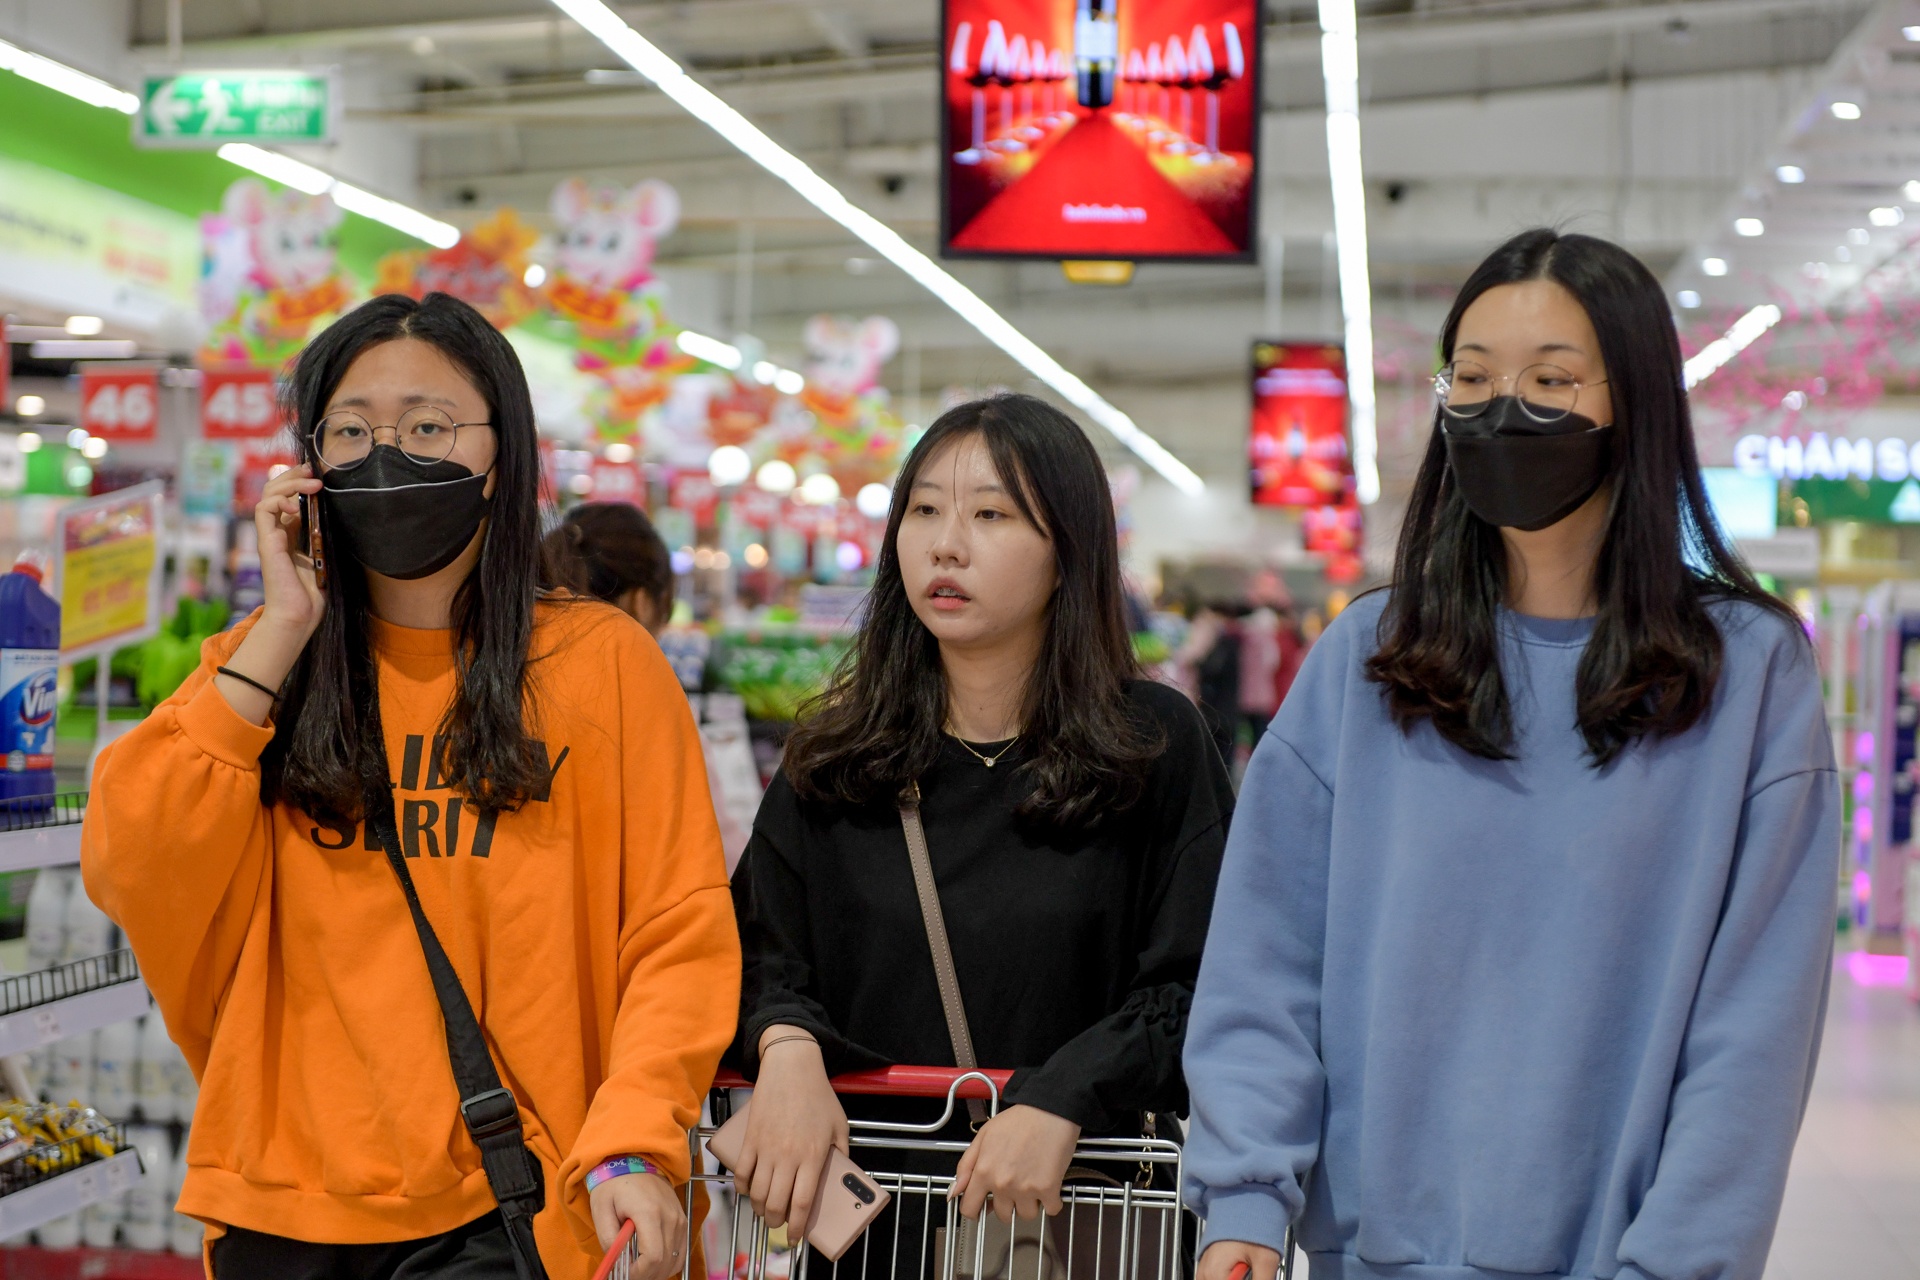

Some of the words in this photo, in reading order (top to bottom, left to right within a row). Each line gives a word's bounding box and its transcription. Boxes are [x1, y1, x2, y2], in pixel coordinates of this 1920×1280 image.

[88, 383, 153, 430] 46
[207, 382, 274, 429] 45
[603, 1159, 627, 1170] HOME
